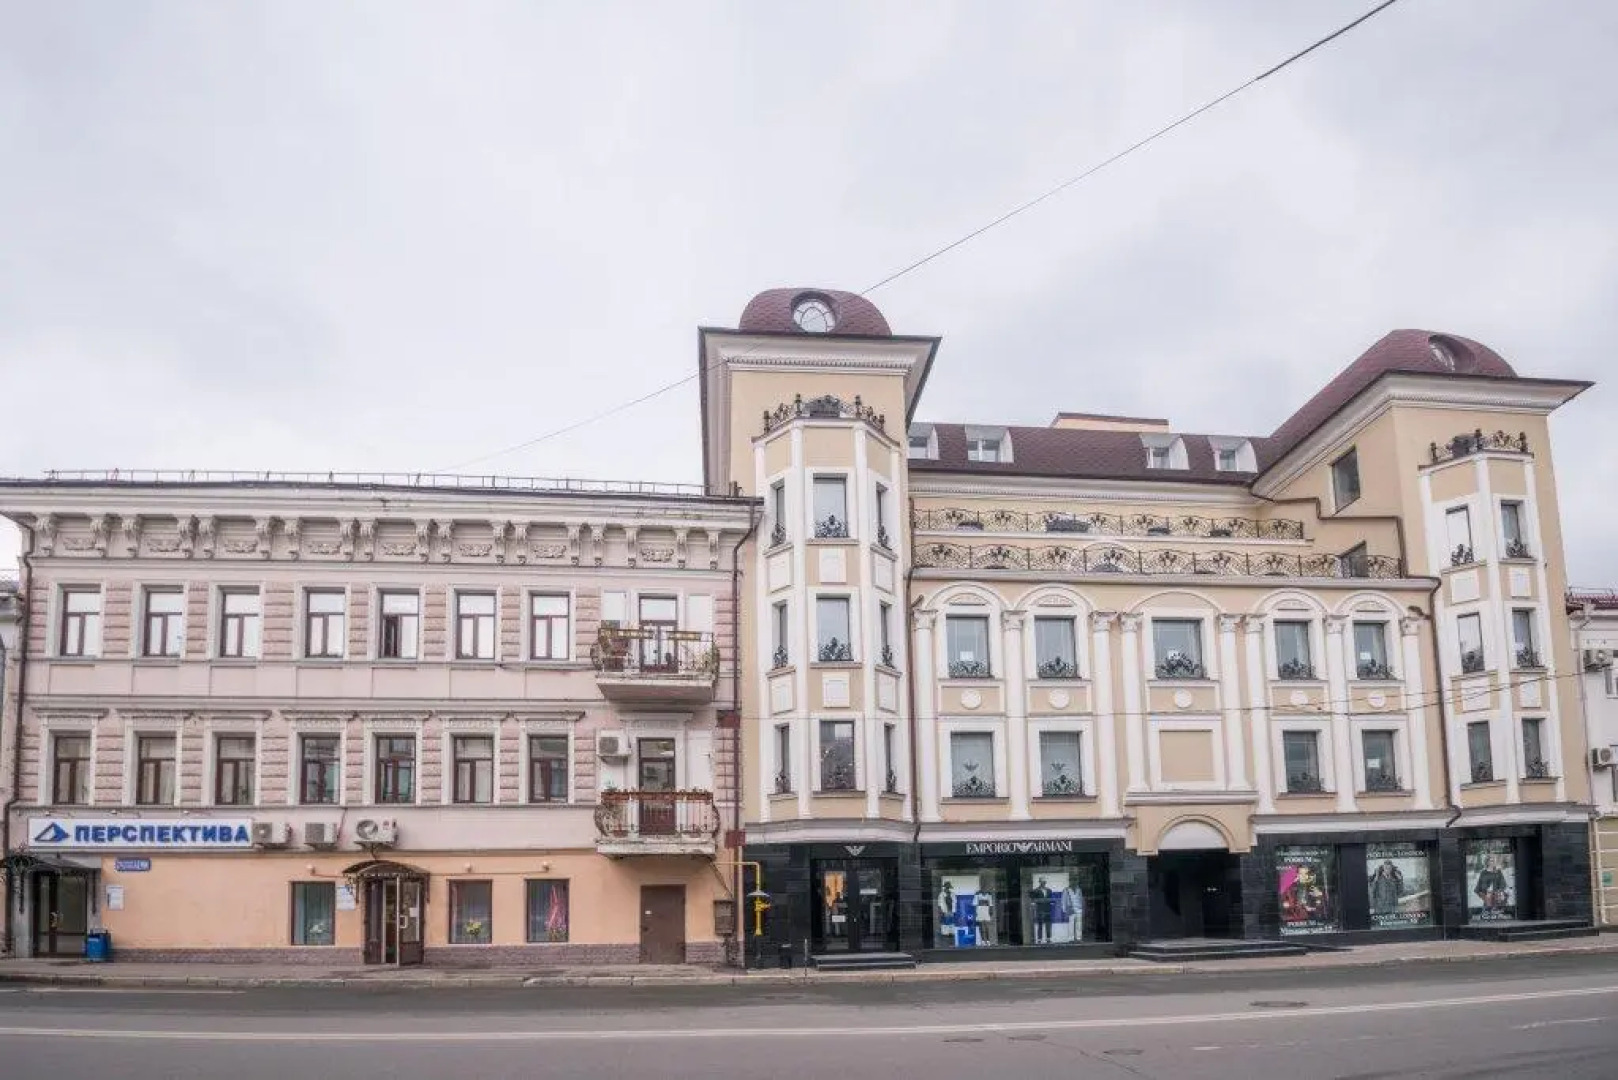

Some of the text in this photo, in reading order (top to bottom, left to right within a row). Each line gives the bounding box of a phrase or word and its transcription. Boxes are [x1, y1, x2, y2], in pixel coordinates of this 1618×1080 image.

[75, 824, 250, 842] ПЕРСПЕКТИВА
[966, 841, 1072, 854] EMPORIO ARMANI
